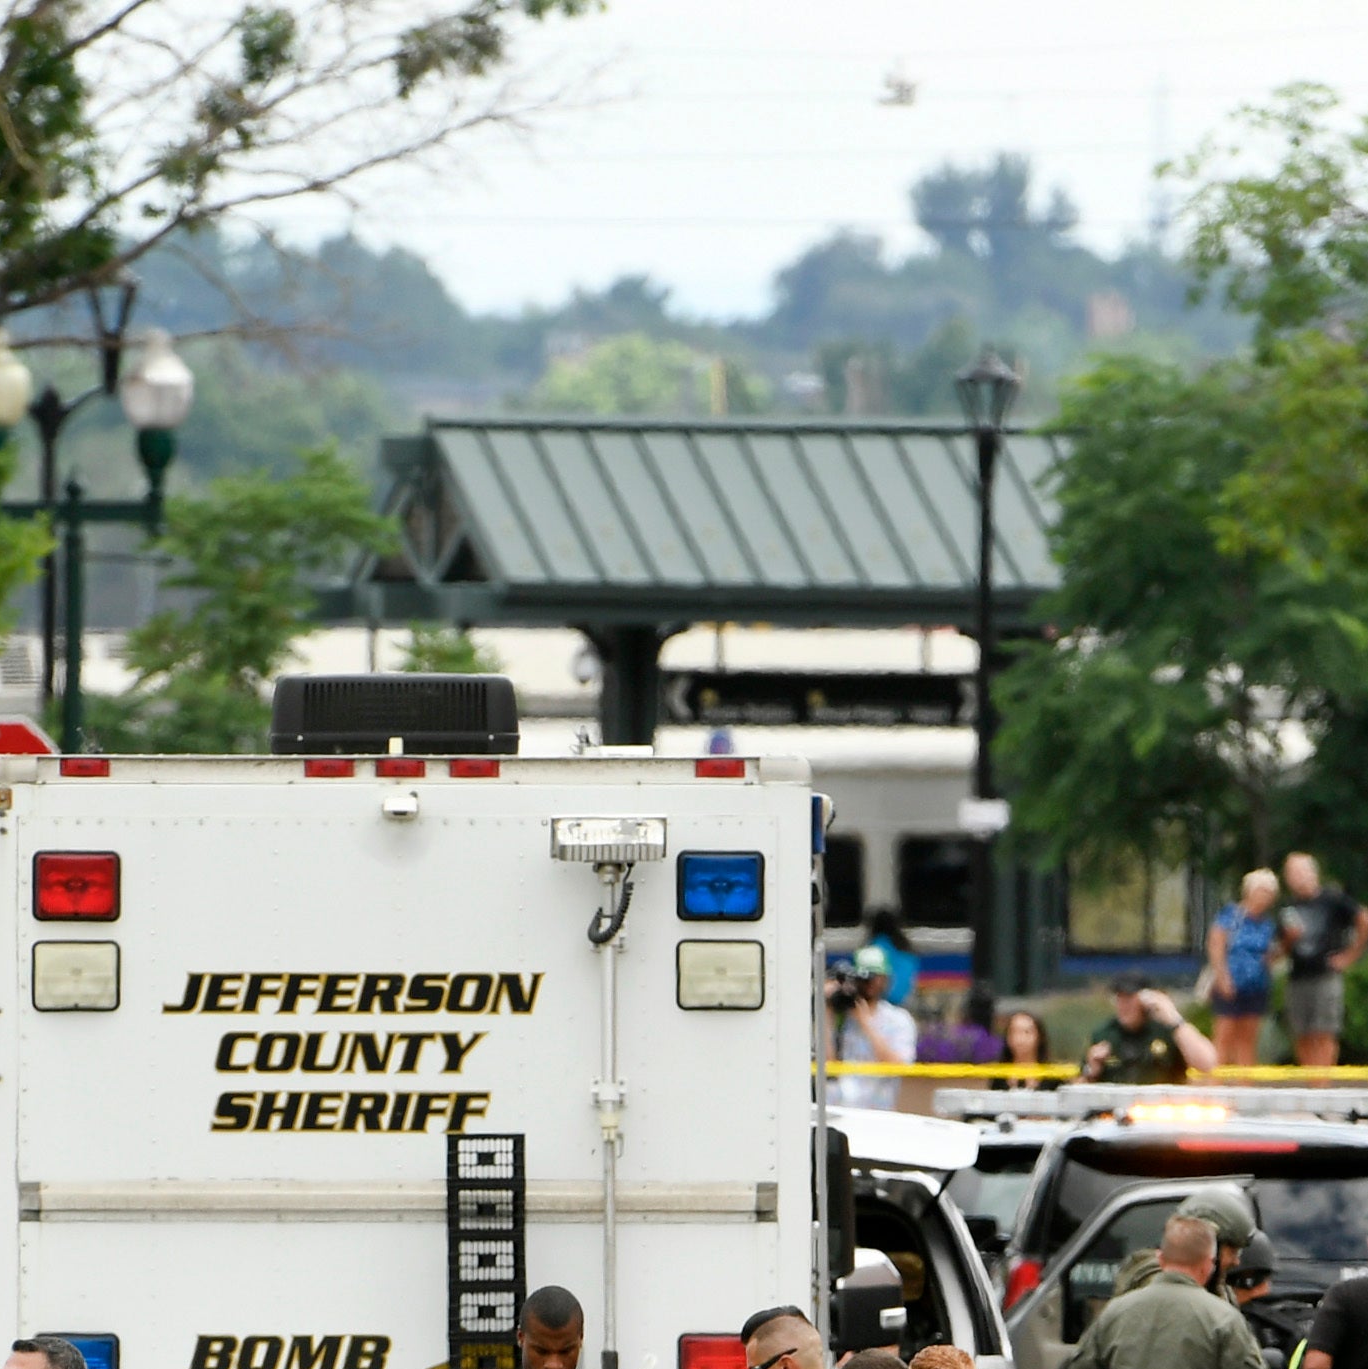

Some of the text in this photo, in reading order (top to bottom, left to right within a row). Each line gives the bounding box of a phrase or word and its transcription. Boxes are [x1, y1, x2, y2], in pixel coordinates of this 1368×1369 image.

[162, 972, 545, 1015] JEFFERSON
[215, 1031, 488, 1073] COUNTY
[210, 1091, 492, 1134] SHERIFF
